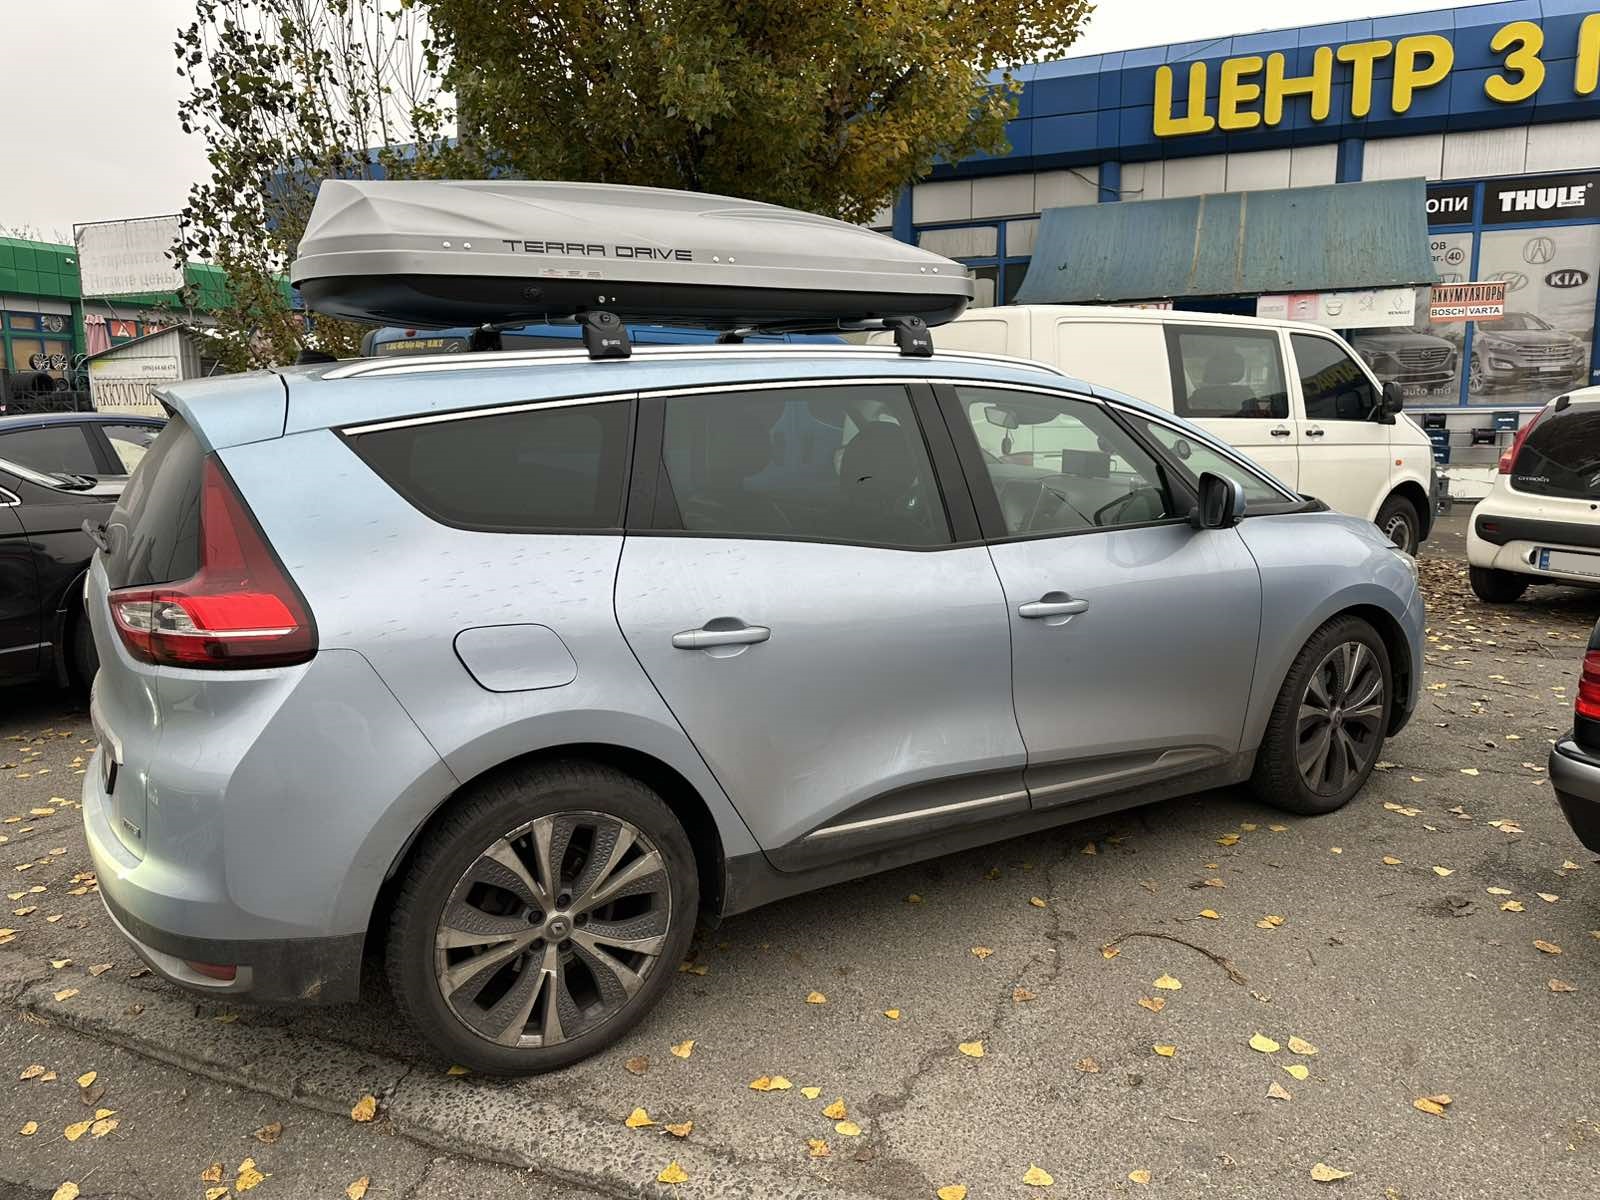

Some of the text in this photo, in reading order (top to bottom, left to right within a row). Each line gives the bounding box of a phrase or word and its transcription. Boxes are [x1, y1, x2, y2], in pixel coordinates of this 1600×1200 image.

[1153, 34, 1454, 137] ЦЕНТР
[1498, 185, 1586, 212] THULE
[502, 239, 693, 262] TERRA DRIVE
[1448, 251, 1462, 261] 40
[1550, 272, 1583, 286] KIA
[1431, 285, 1505, 304] АККУМУЛЯТОРЫ
[1431, 306, 1501, 316] BOSCH VARTA
